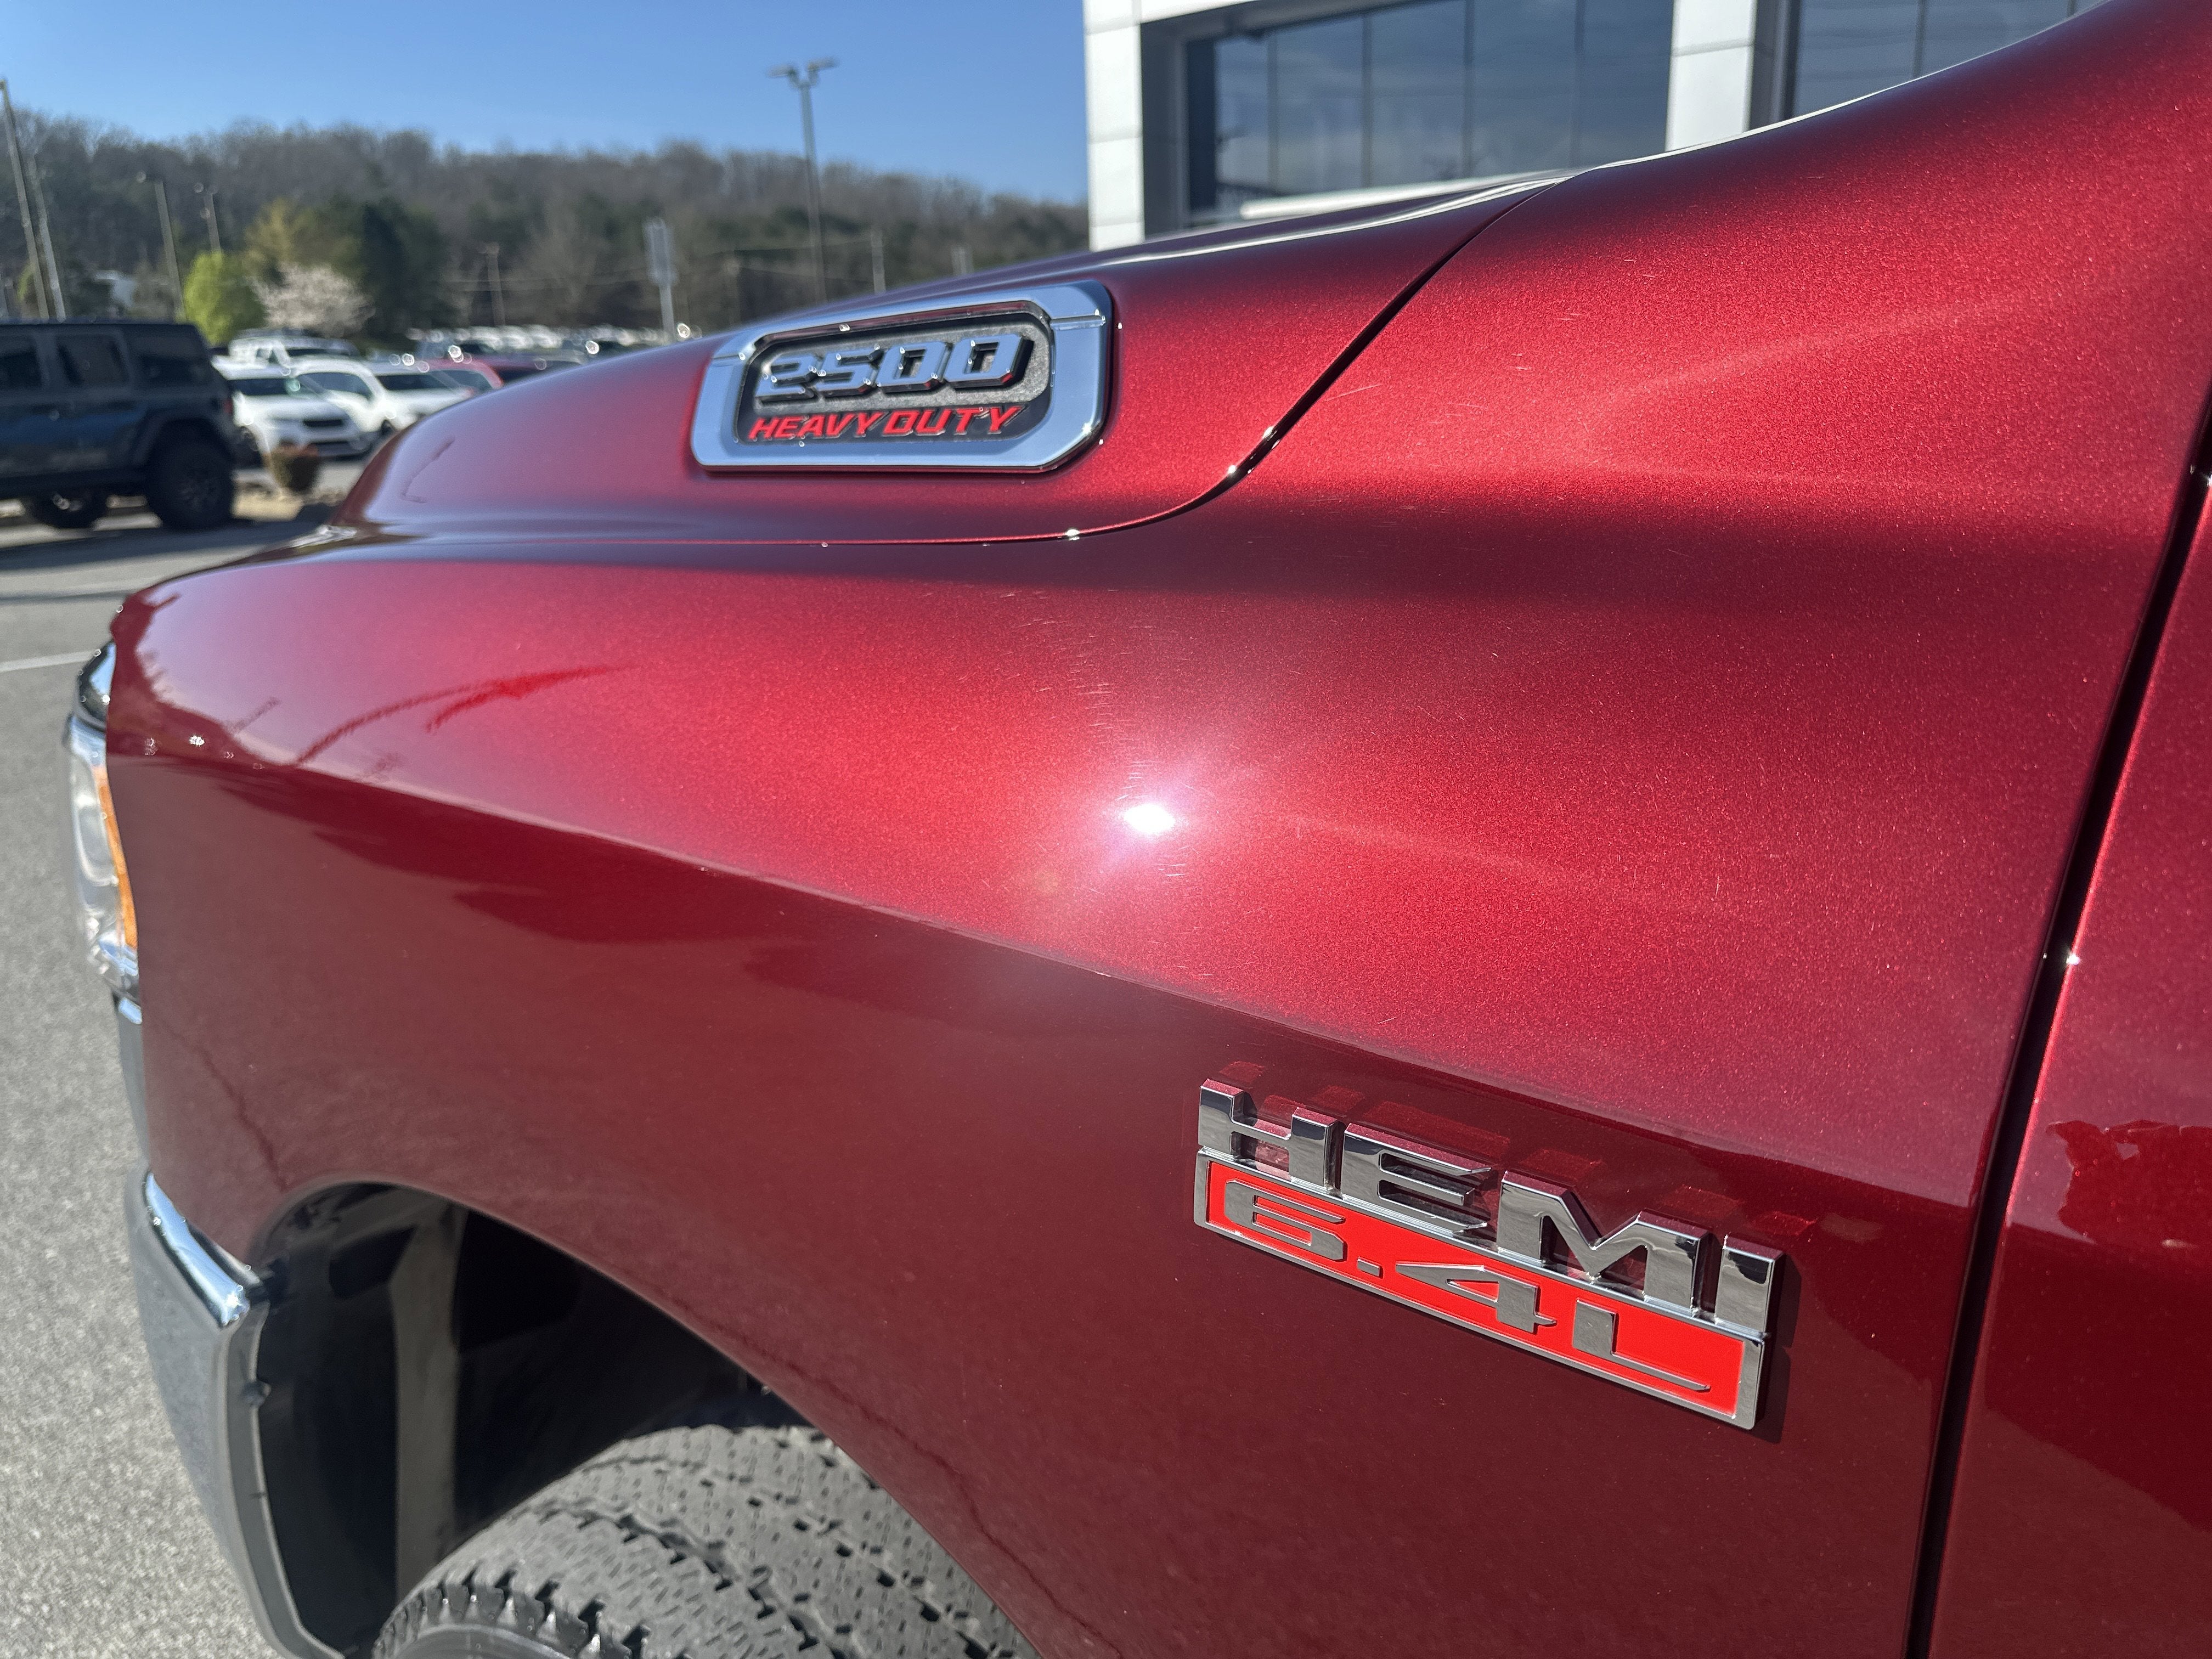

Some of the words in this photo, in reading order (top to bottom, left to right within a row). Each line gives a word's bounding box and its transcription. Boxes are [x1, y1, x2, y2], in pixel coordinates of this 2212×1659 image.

[748, 412, 884, 441] HEAVY
[882, 406, 1023, 436] DUTY
[755, 332, 1032, 399] 2500
[1198, 1079, 1784, 1336] HEMI
[1223, 1178, 1711, 1392] 6.4L
